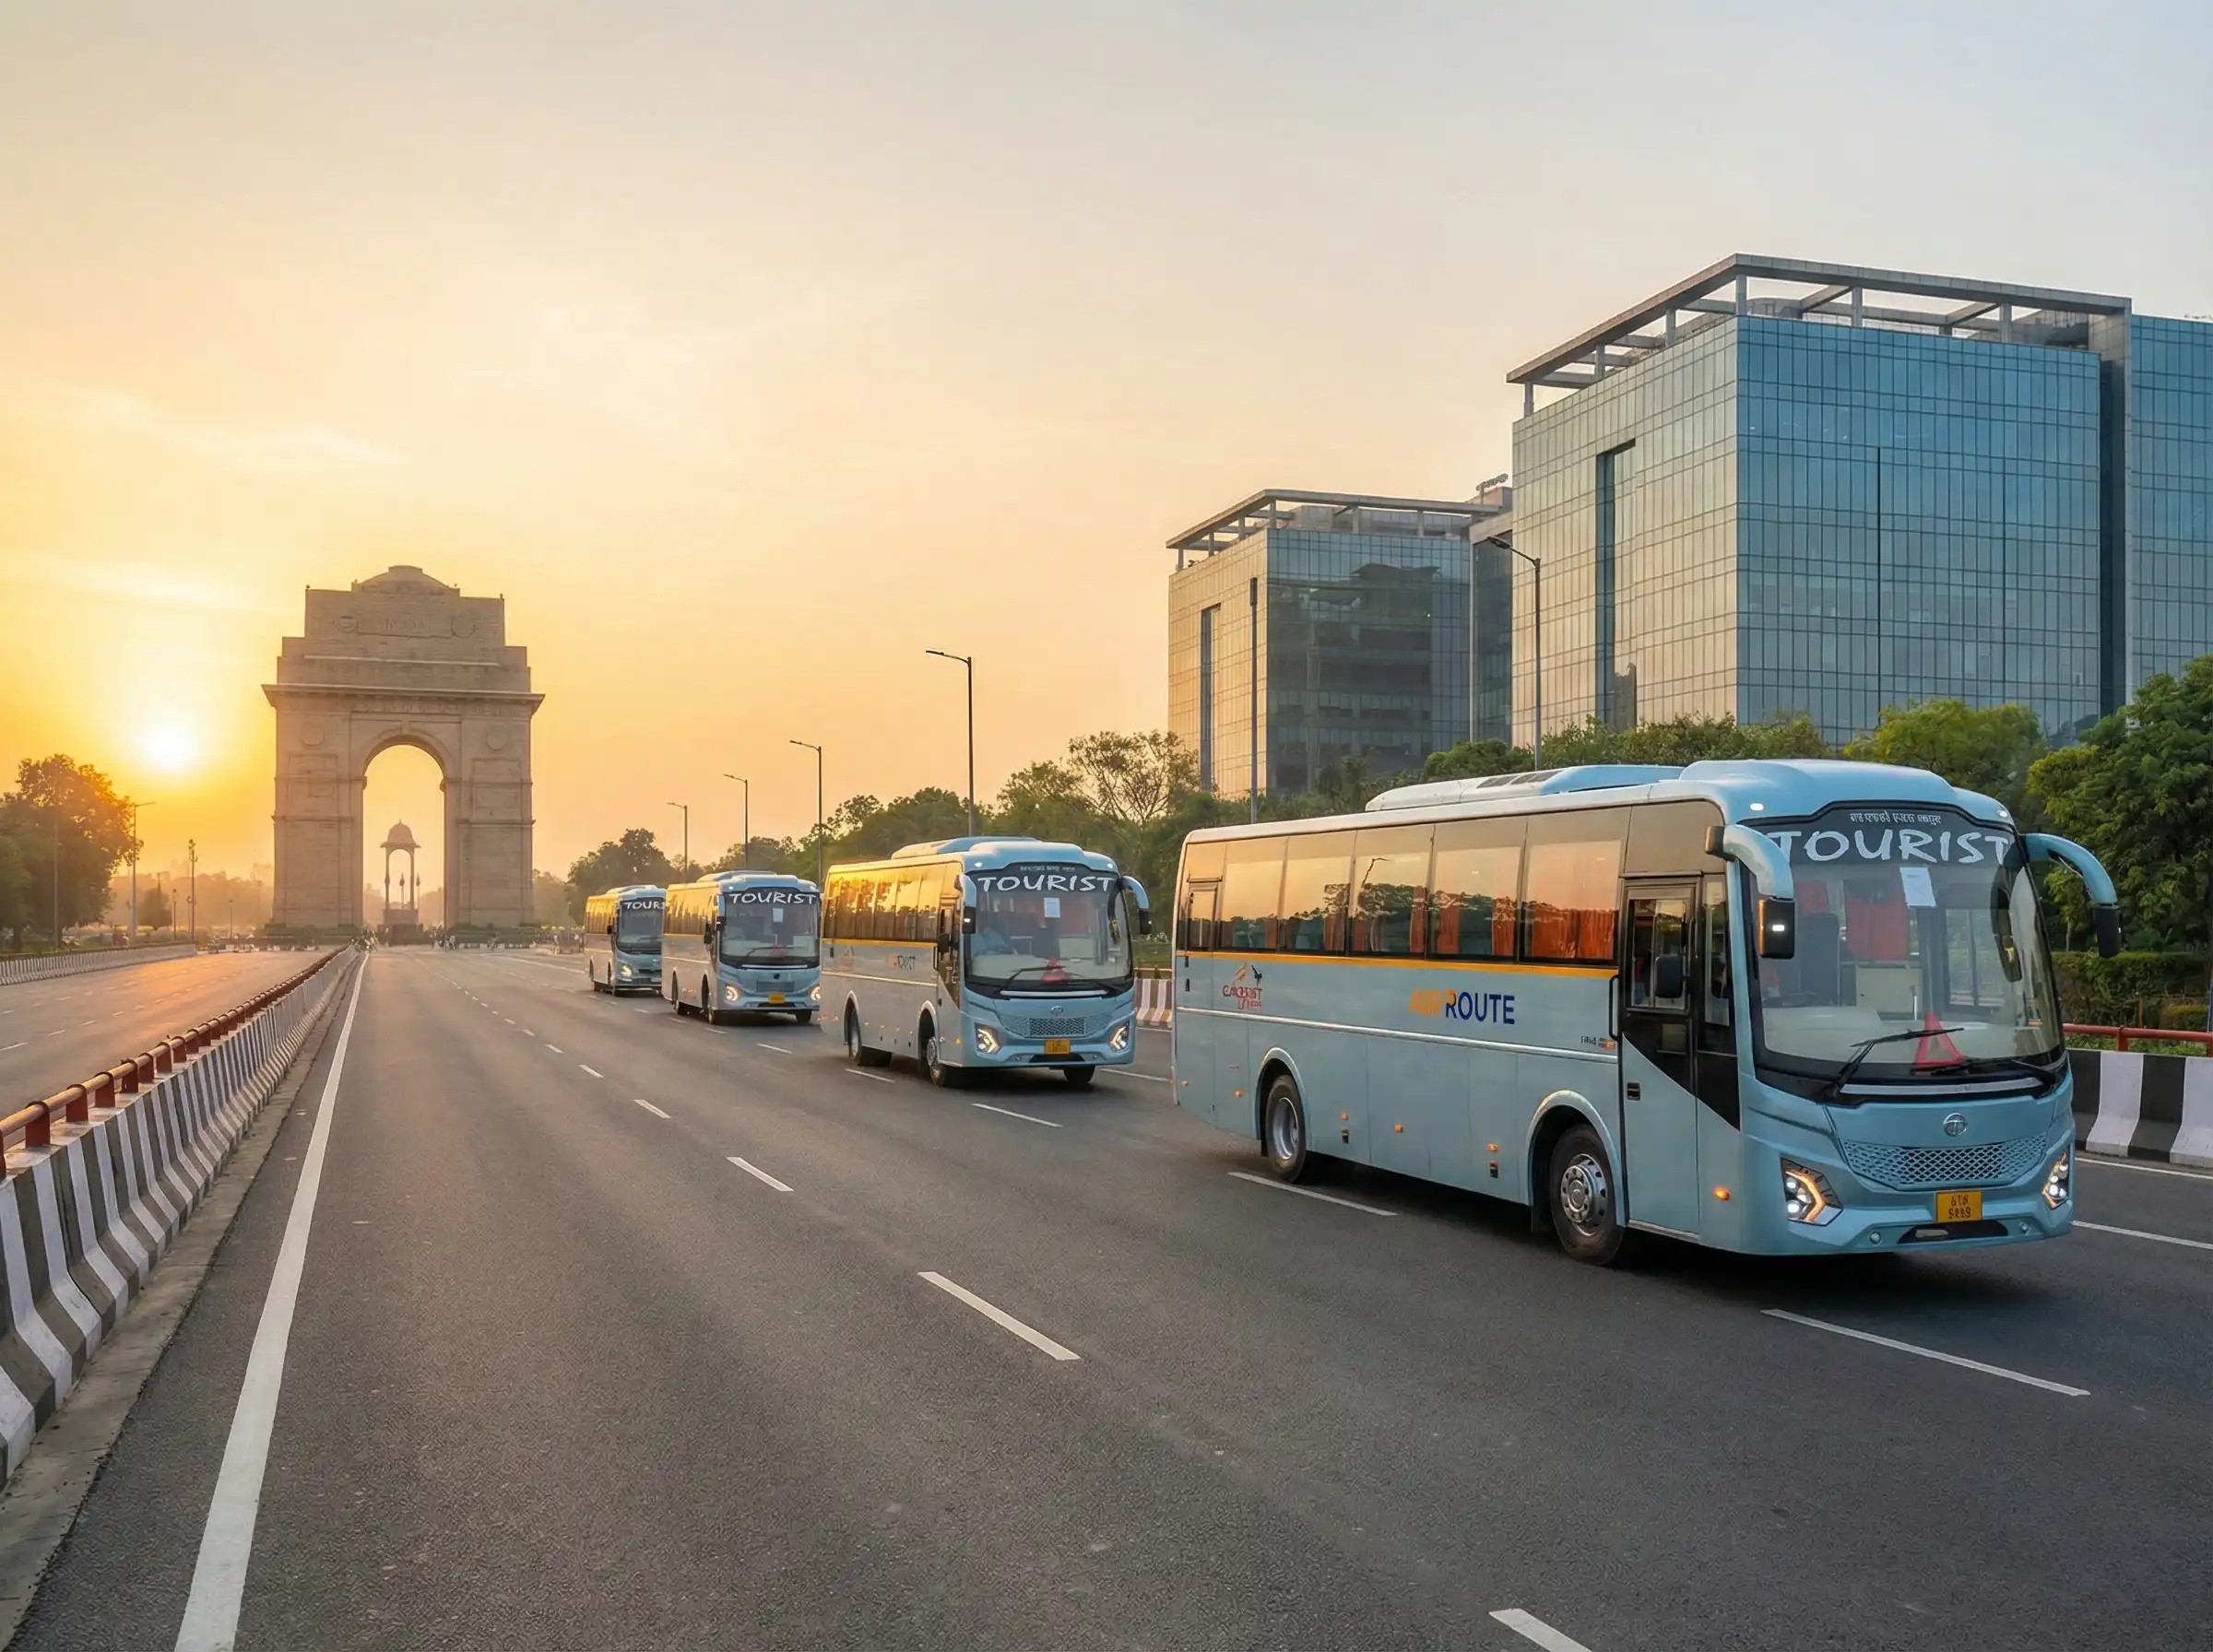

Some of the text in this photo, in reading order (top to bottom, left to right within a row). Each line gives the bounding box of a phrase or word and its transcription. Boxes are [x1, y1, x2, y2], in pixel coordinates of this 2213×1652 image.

[1766, 829, 2015, 865] TOURIST
[977, 875, 1115, 892] TOURIST
[728, 891, 817, 904] TOURIST
